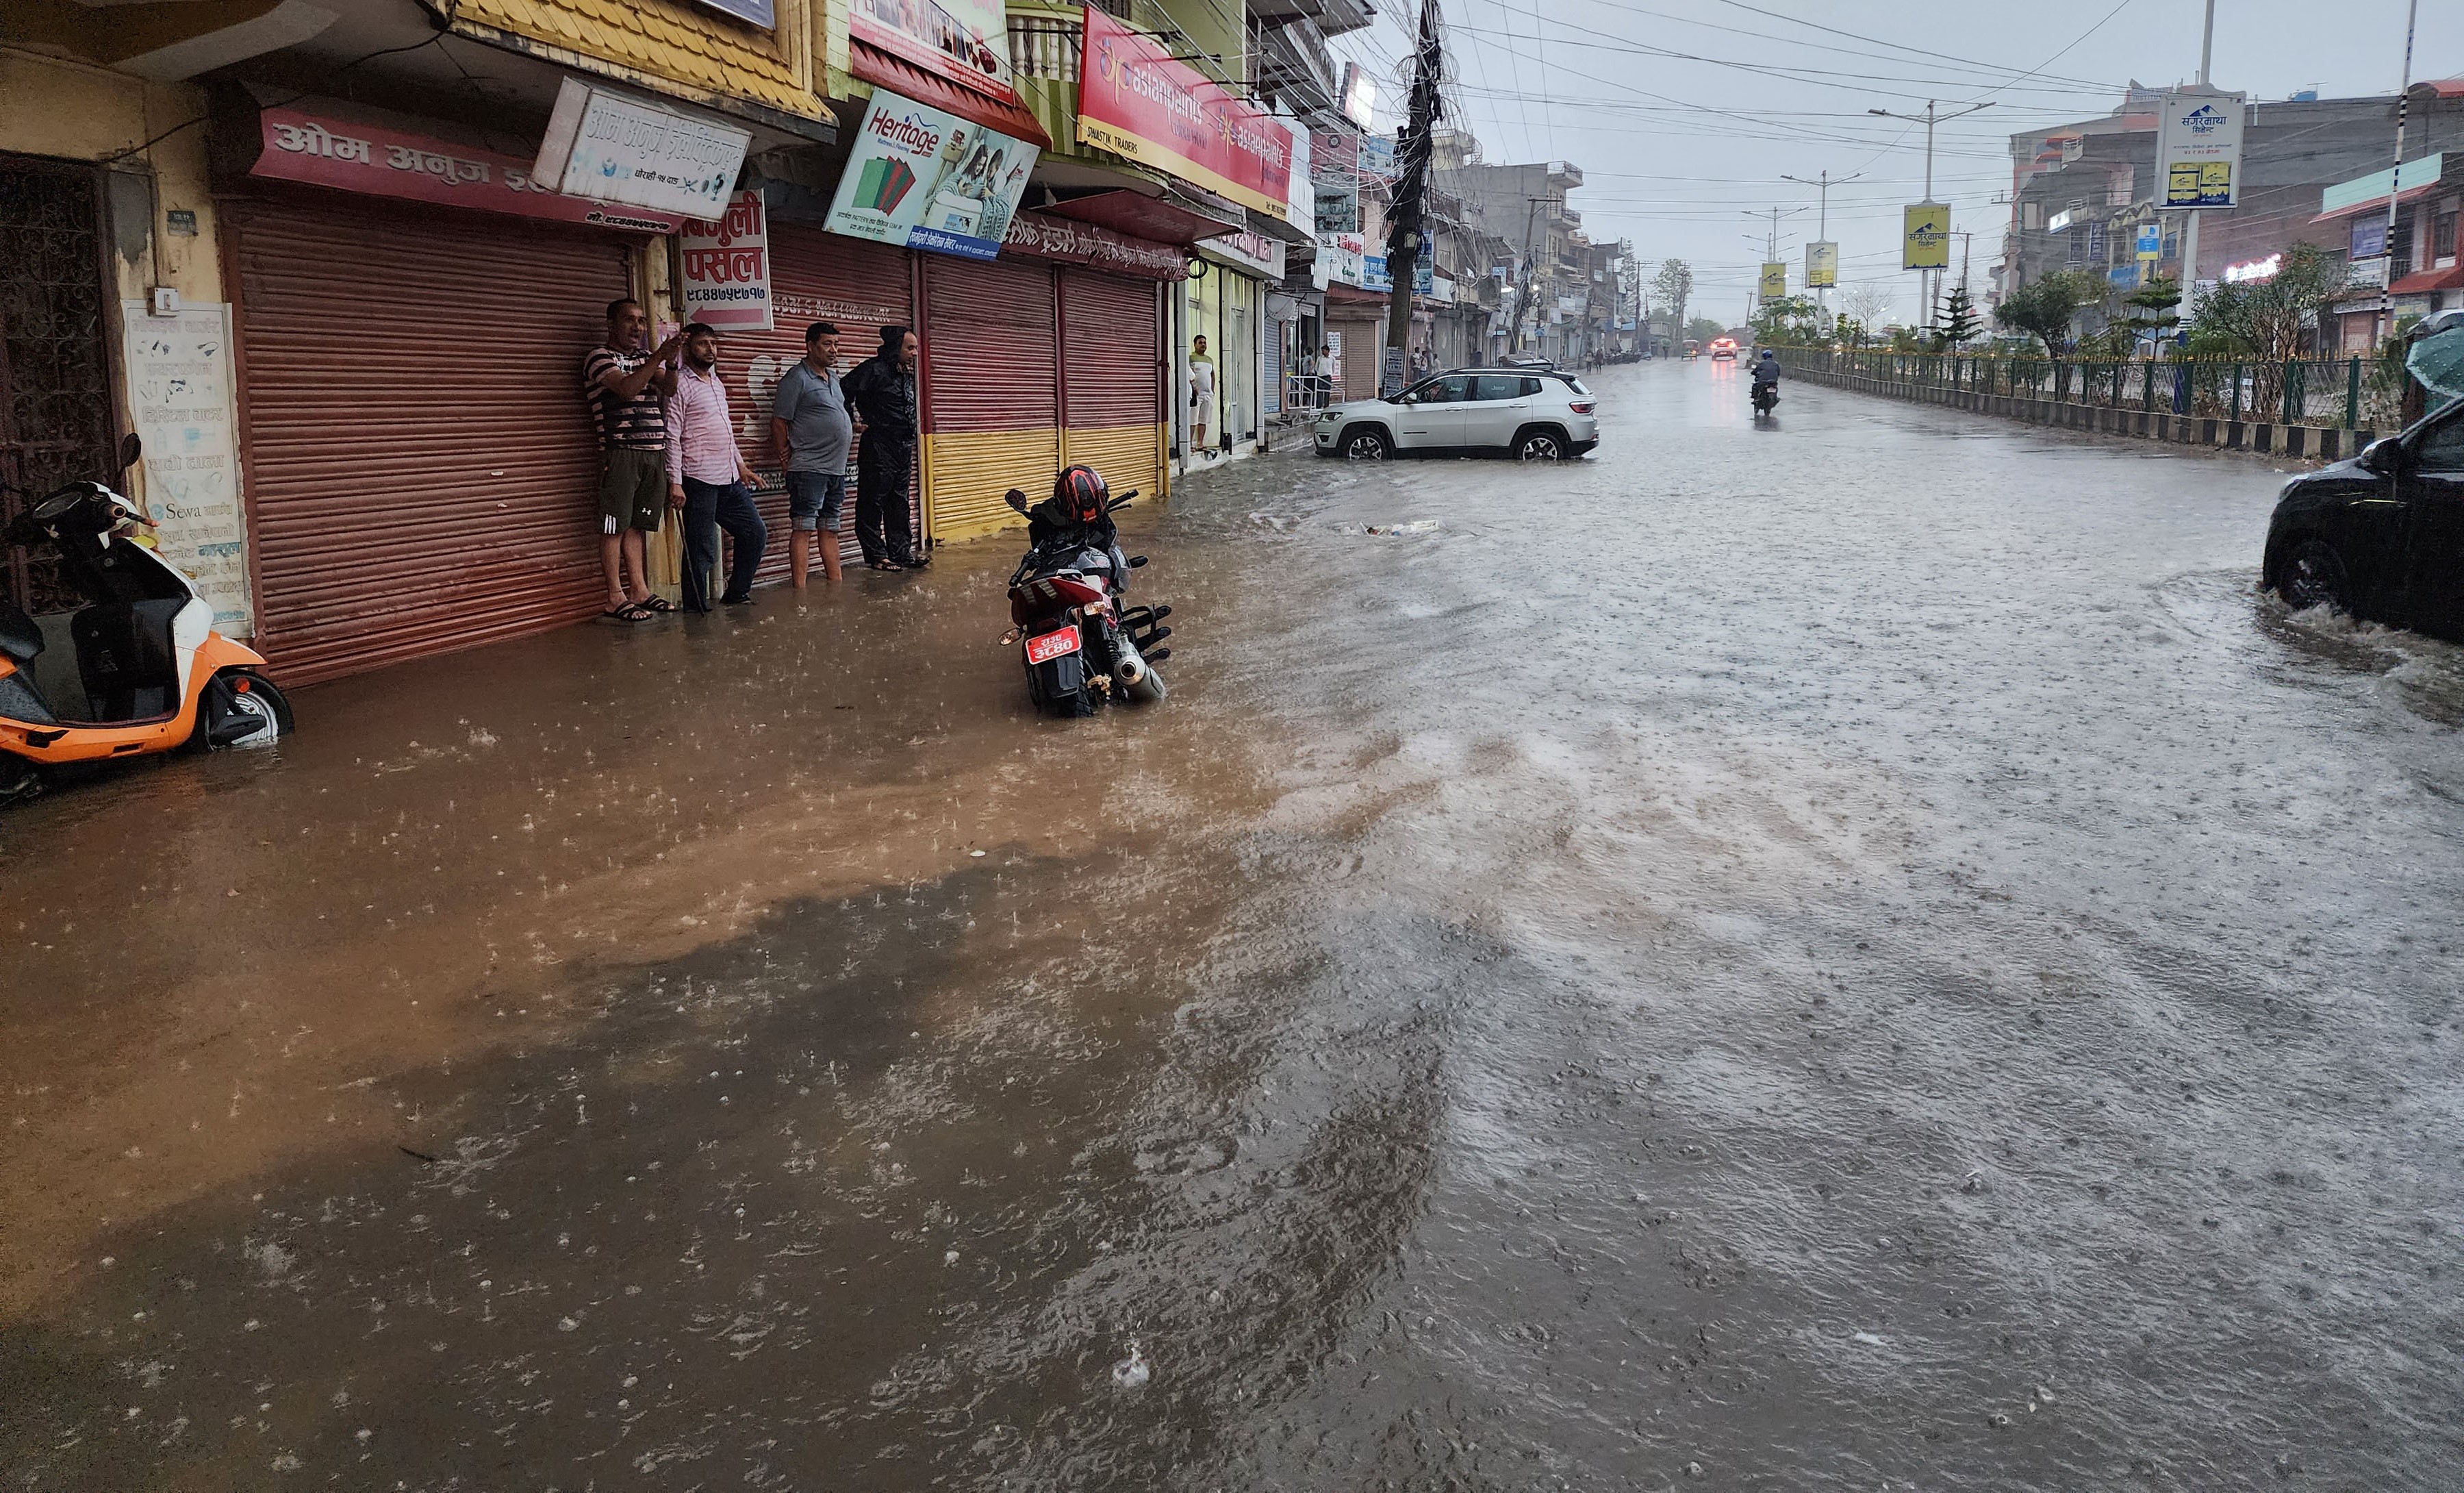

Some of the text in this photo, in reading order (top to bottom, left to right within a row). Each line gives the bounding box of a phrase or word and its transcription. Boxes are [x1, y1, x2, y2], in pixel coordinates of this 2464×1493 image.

[1132, 62, 1202, 125] asianpaints
[867, 107, 939, 156] Heritage
[2181, 116, 2227, 127] सगरमाथा
[273, 122, 372, 164] ओम
[384, 144, 491, 186] अनुज
[1087, 126, 1138, 154] SWASTIK TRADERS
[1908, 232, 1947, 241] सगरमाथा
[683, 247, 763, 284] पसल
[1034, 640, 1073, 659] ३८४०
